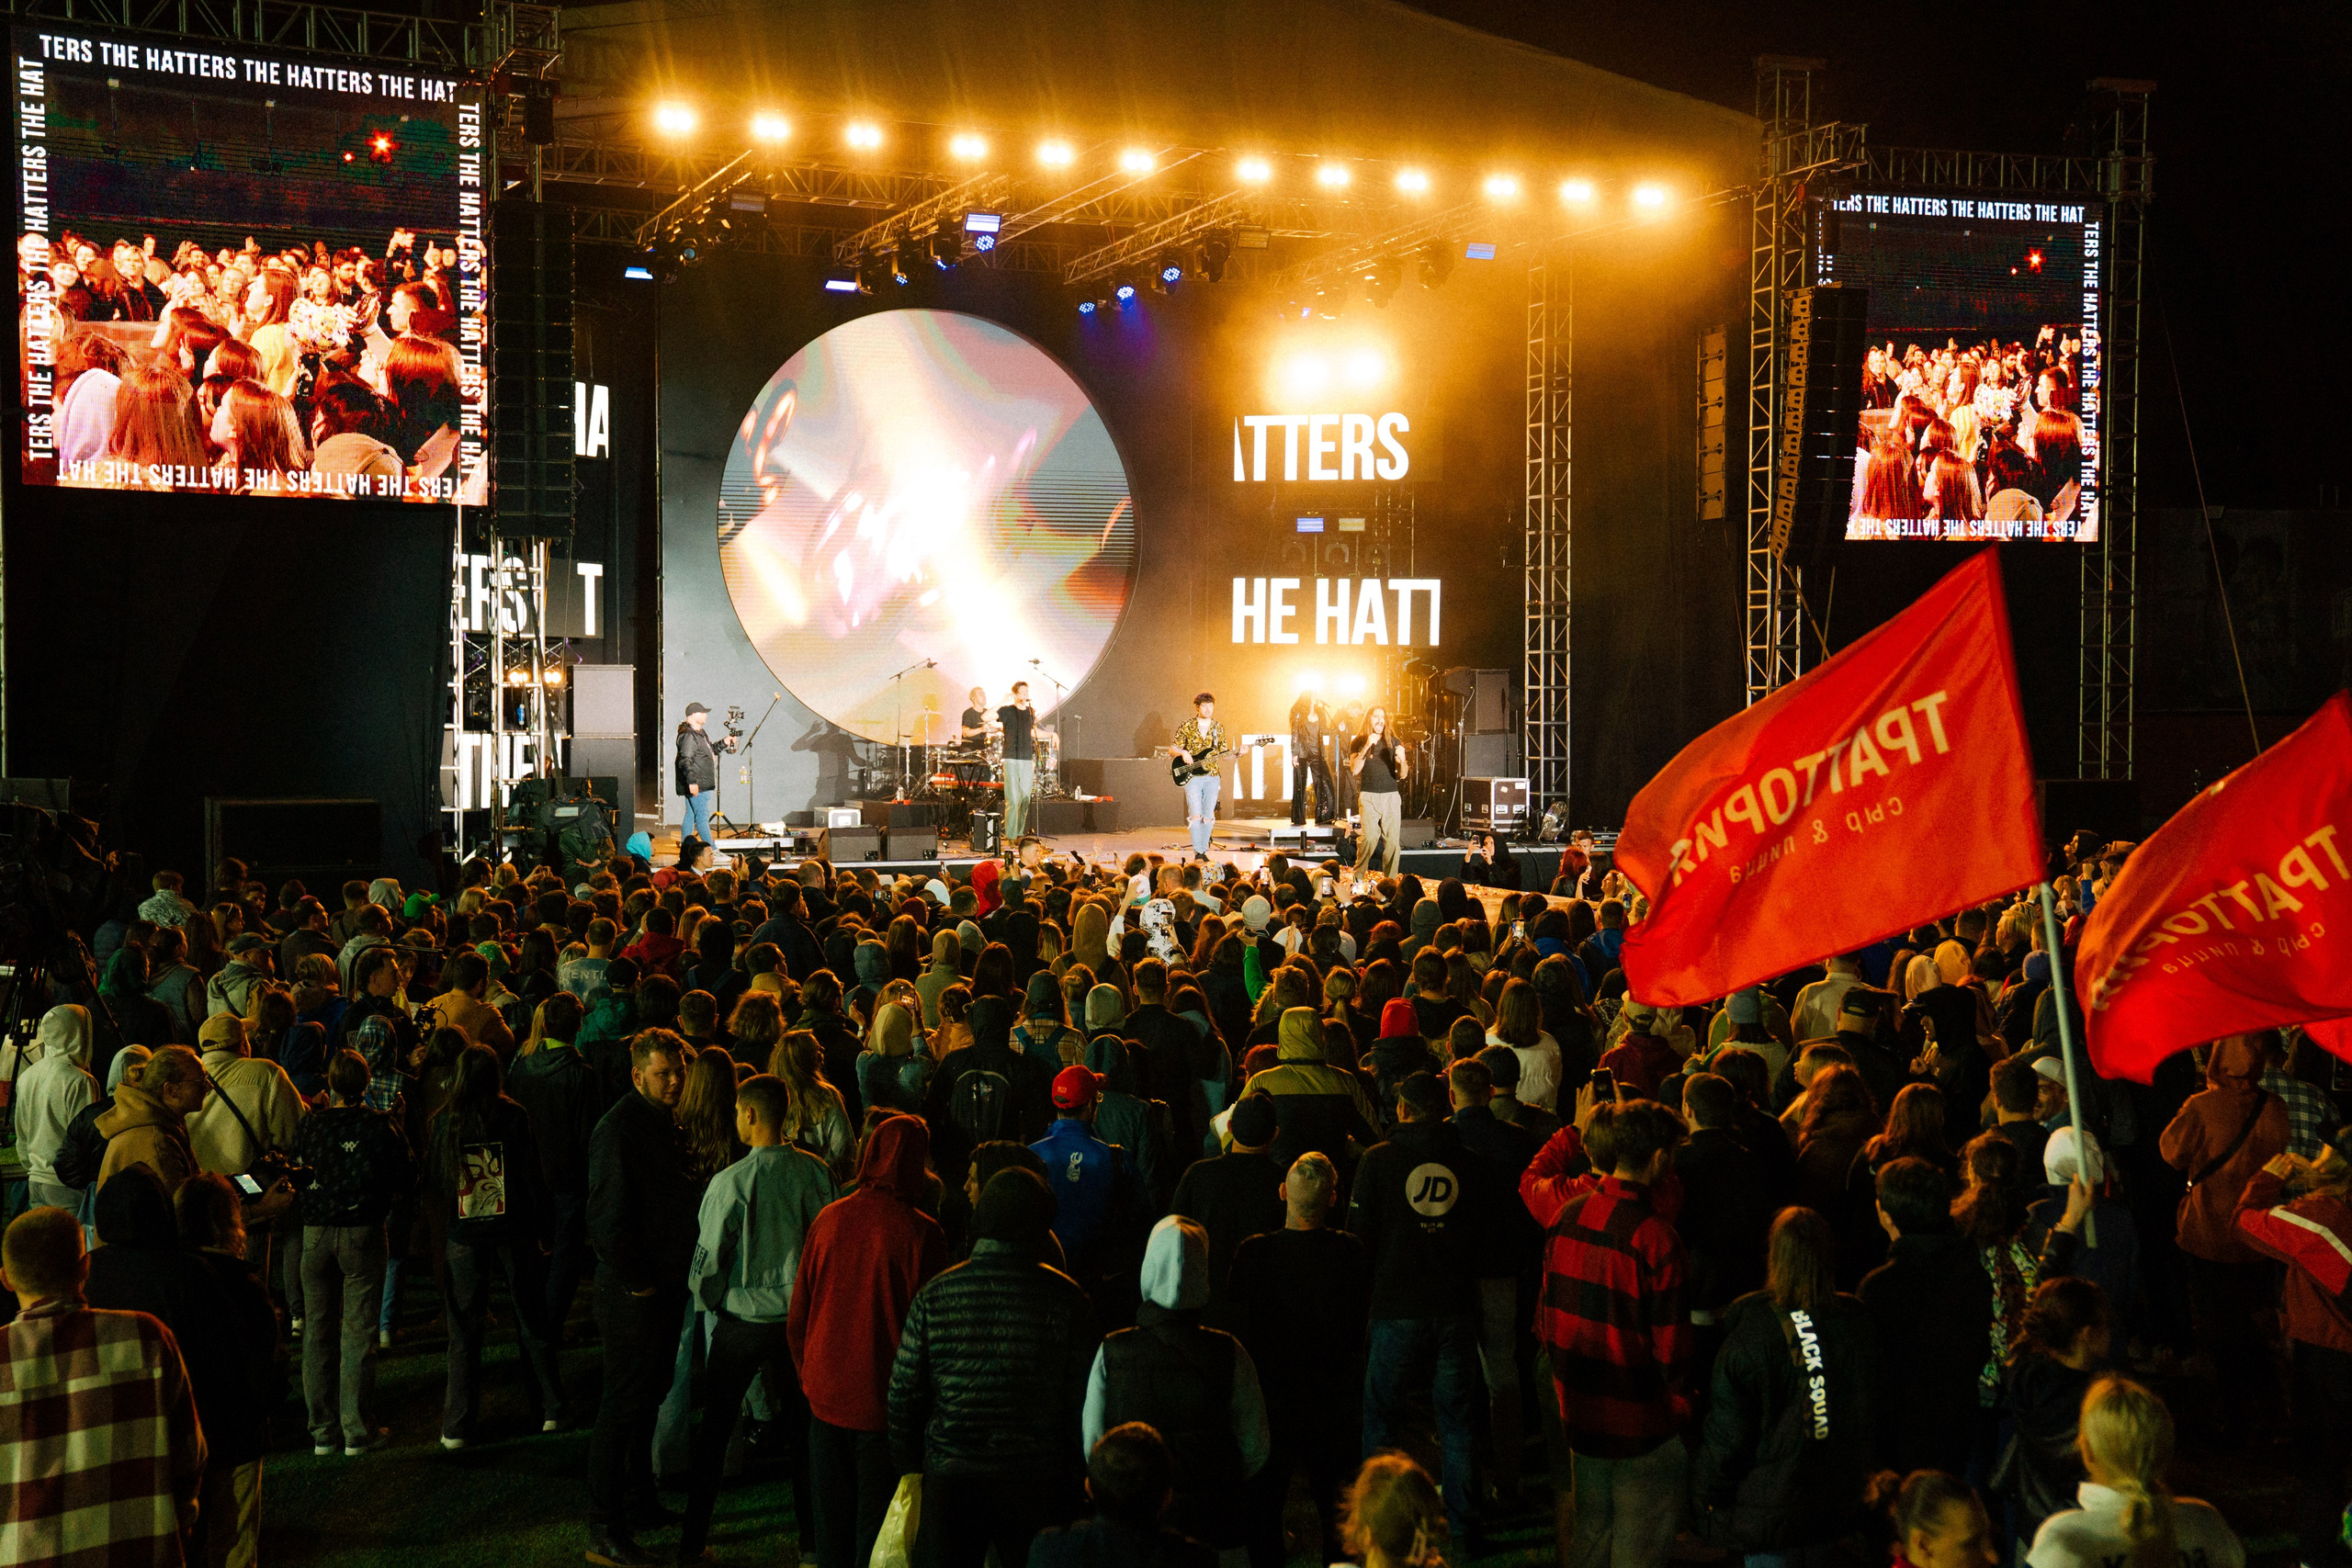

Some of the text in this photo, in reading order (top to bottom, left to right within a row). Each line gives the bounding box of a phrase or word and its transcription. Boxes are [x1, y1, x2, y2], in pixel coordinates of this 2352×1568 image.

[40, 34, 458, 103] TERS THE HATTERS THE HATTERS THE HAT
[1866, 196, 1889, 213] THE
[1893, 197, 1948, 217] HATTERS
[1951, 200, 1974, 218] THE
[1978, 201, 2031, 220] HATTERS
[2035, 204, 2057, 222] THE
[2061, 206, 2085, 223] HAT
[18, 56, 52, 461] TERS THE HATTERS THE HATTERS THE HAT
[459, 103, 481, 476] TERS THE HATTERS THE HATTERS THE HAT
[2080, 221, 2099, 519] TERS THE HATTERS THE HATTERS THE HAT
[57, 459, 465, 499] TERS THE HATTERS THE HATTERS THE HAT
[1860, 518, 1883, 536] THE
[1885, 518, 1939, 536] HATTERS
[1943, 519, 1967, 536] THE
[1969, 520, 2023, 537] HATTERS
[2026, 521, 2050, 537] THE
[1232, 578, 1300, 644] HE
[1413, 1176, 1453, 1203] JD
[1791, 1310, 1828, 1439] BLACK SQUAD
